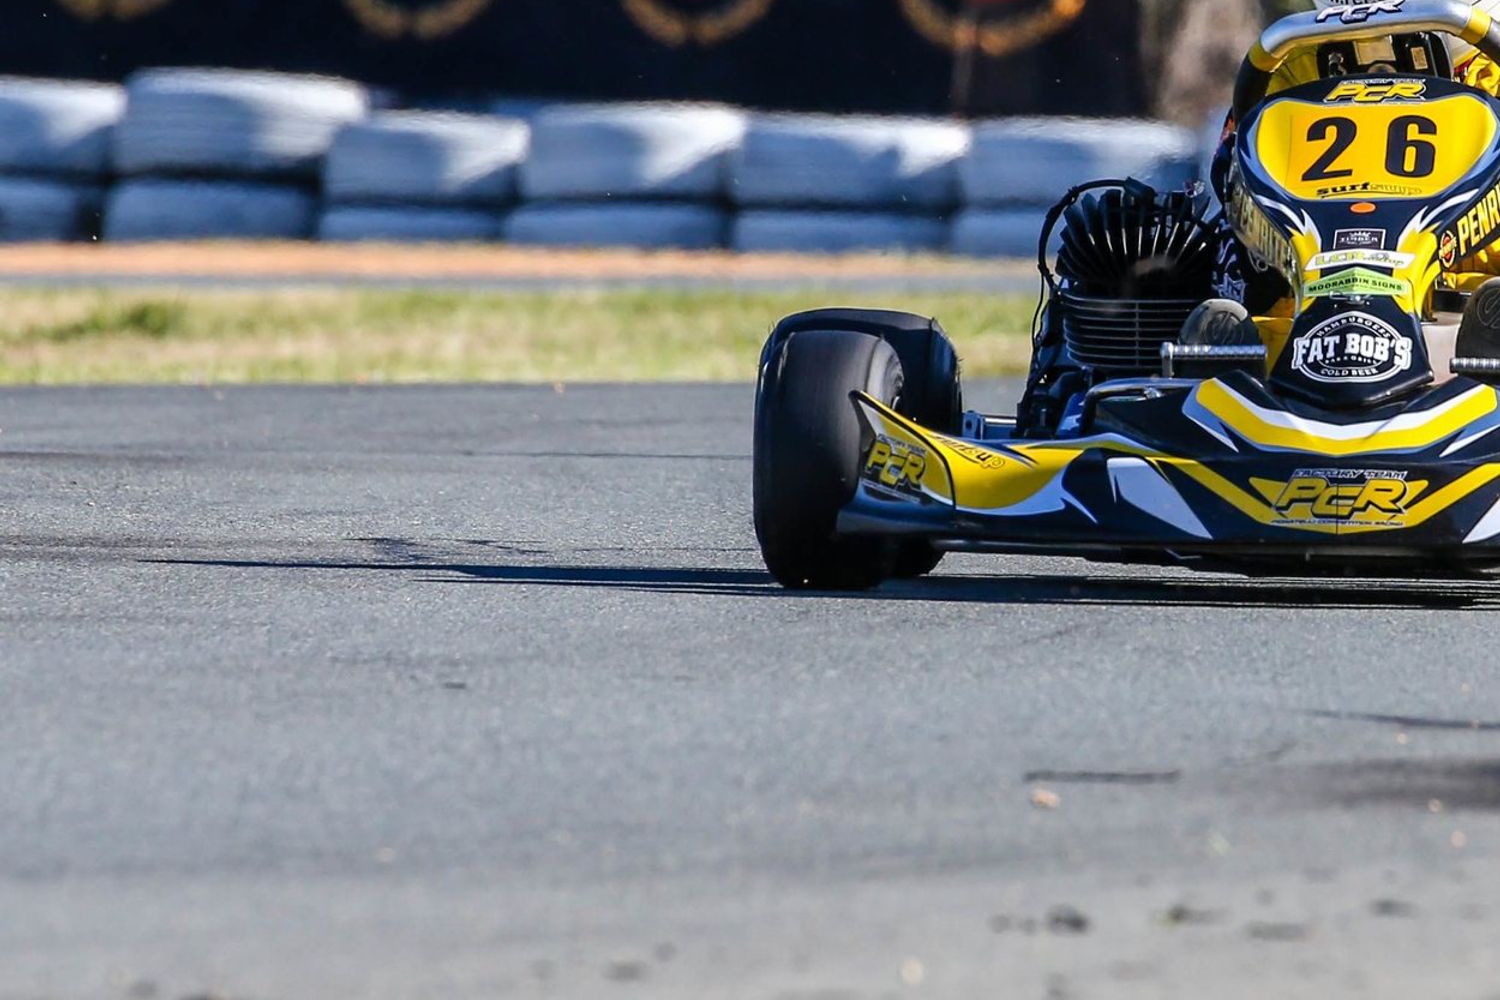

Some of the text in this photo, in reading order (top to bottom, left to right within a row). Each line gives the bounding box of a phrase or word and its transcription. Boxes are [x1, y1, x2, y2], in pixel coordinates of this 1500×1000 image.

[1316, 0, 1405, 24] PCR
[1325, 81, 1427, 103] PCR
[1301, 114, 1438, 181] 26
[1308, 277, 1403, 293] MOORABBIN SIGNS
[1316, 316, 1392, 339] HAMBURGERS
[1294, 332, 1412, 370] FAT BOB'S
[1320, 367, 1379, 377] COLD BEER
[866, 439, 926, 488] PCR
[1294, 468, 1408, 480] FACTORY TEAM
[1275, 477, 1407, 518] PCR
